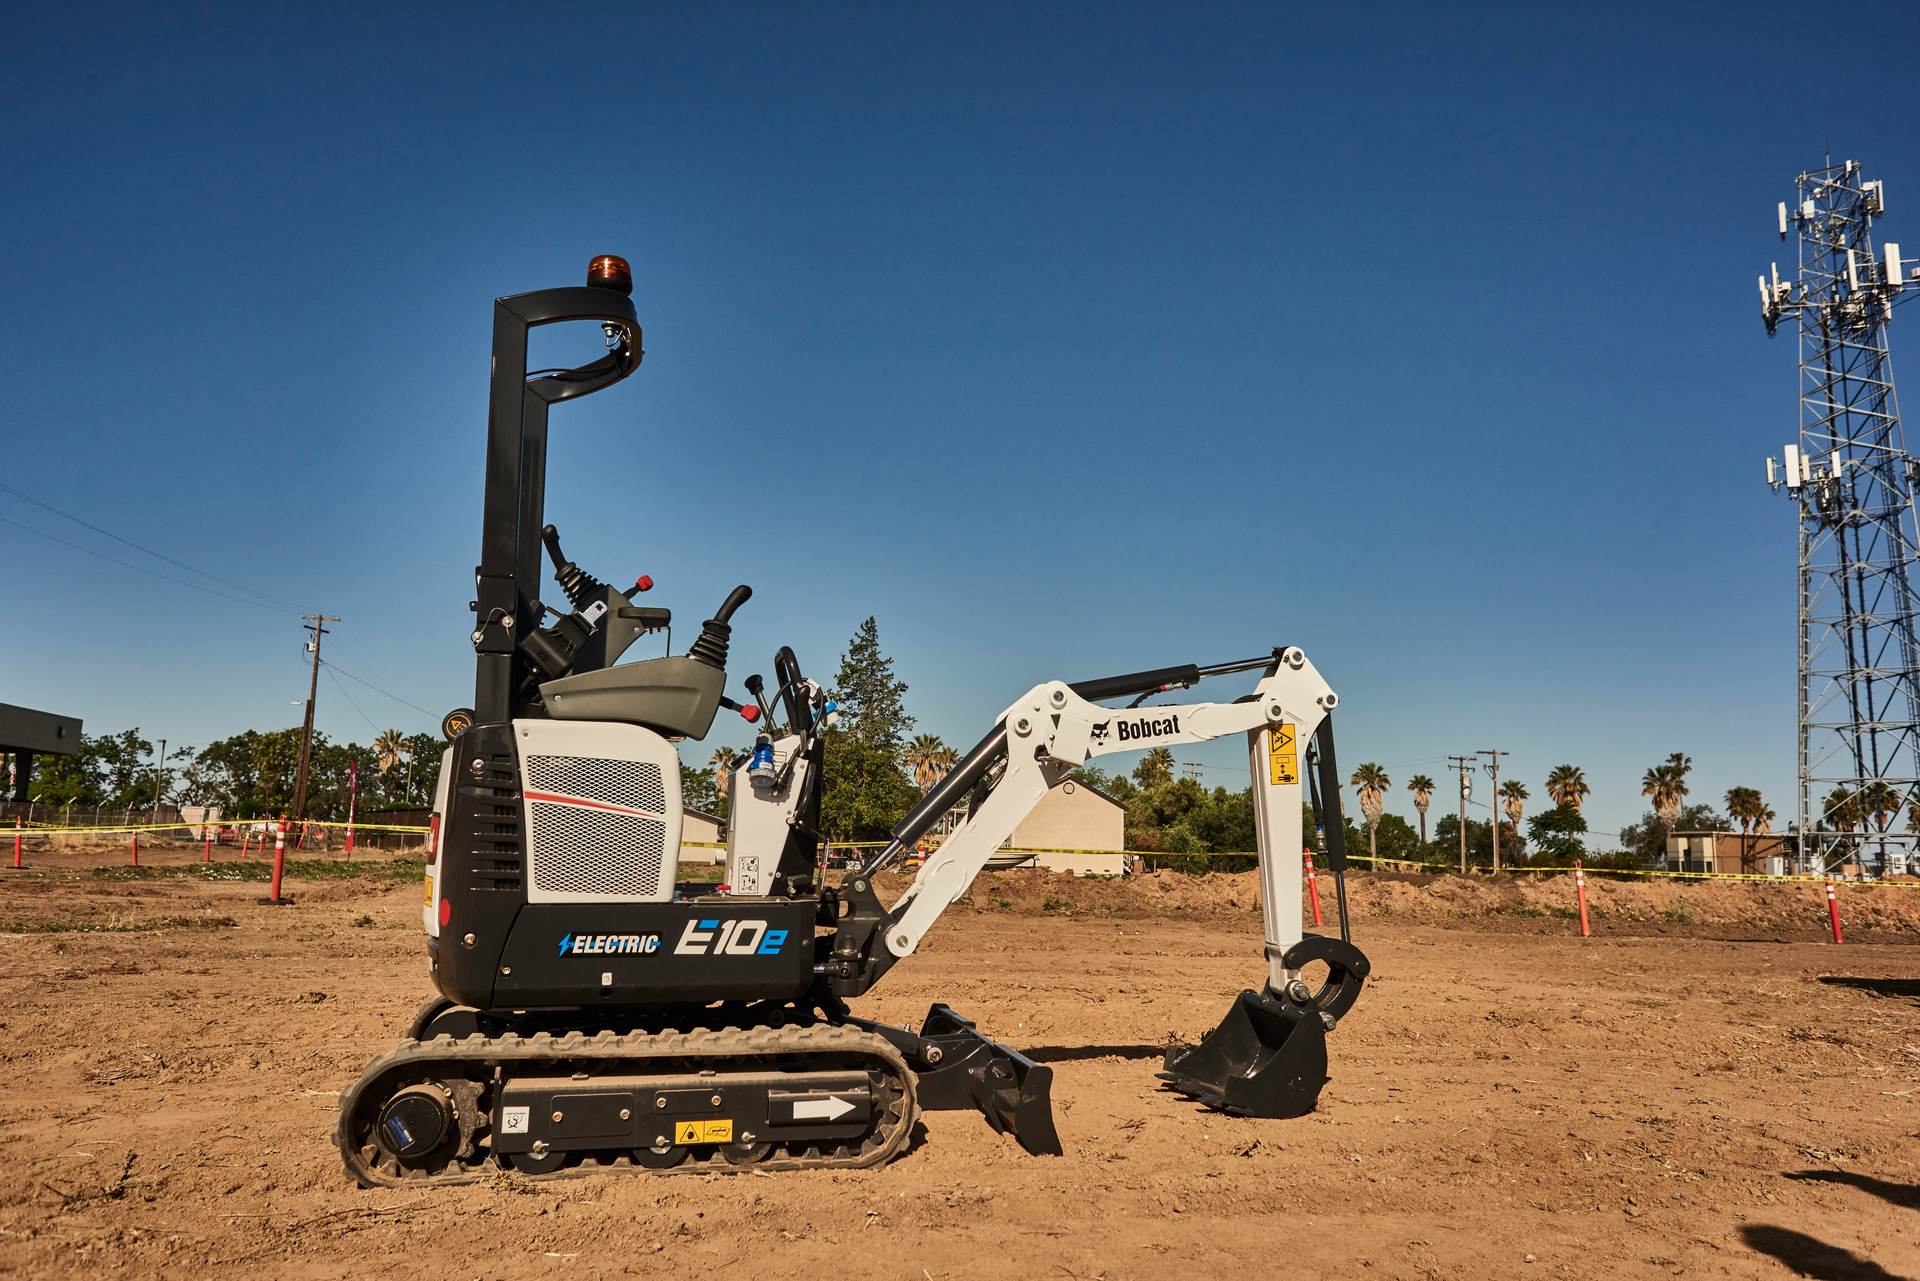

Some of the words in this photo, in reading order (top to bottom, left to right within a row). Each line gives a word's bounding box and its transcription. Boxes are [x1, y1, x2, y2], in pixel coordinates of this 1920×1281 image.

[1117, 715, 1181, 741] Bobcat
[572, 935, 659, 954] ELECTRIC
[673, 919, 789, 955] E10e
